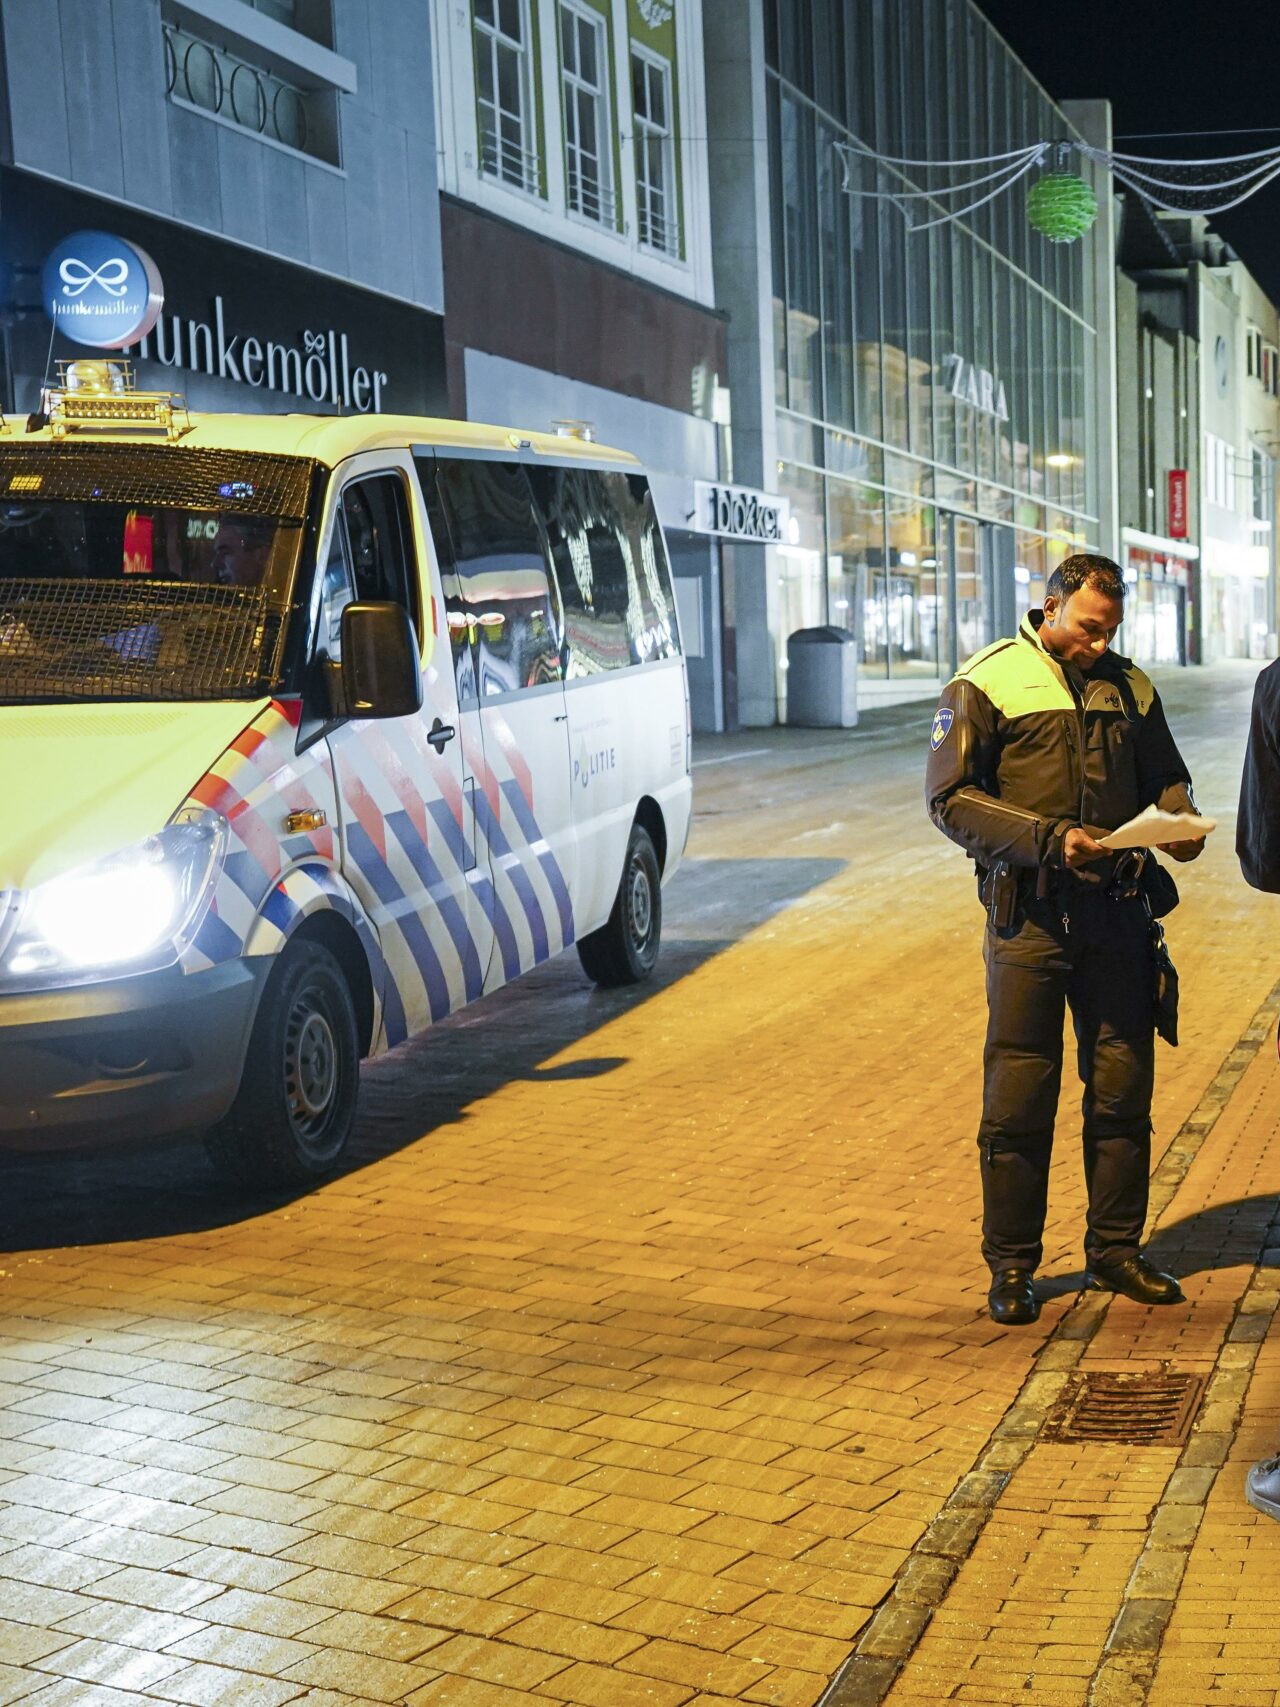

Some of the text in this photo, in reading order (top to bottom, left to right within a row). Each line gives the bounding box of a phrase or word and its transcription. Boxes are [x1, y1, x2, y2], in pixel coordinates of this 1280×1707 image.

[52, 298, 141, 316] hunkemöller
[122, 296, 388, 414] unkemöller
[942, 353, 1010, 422] ZARA
[573, 747, 616, 789] POLITIE
